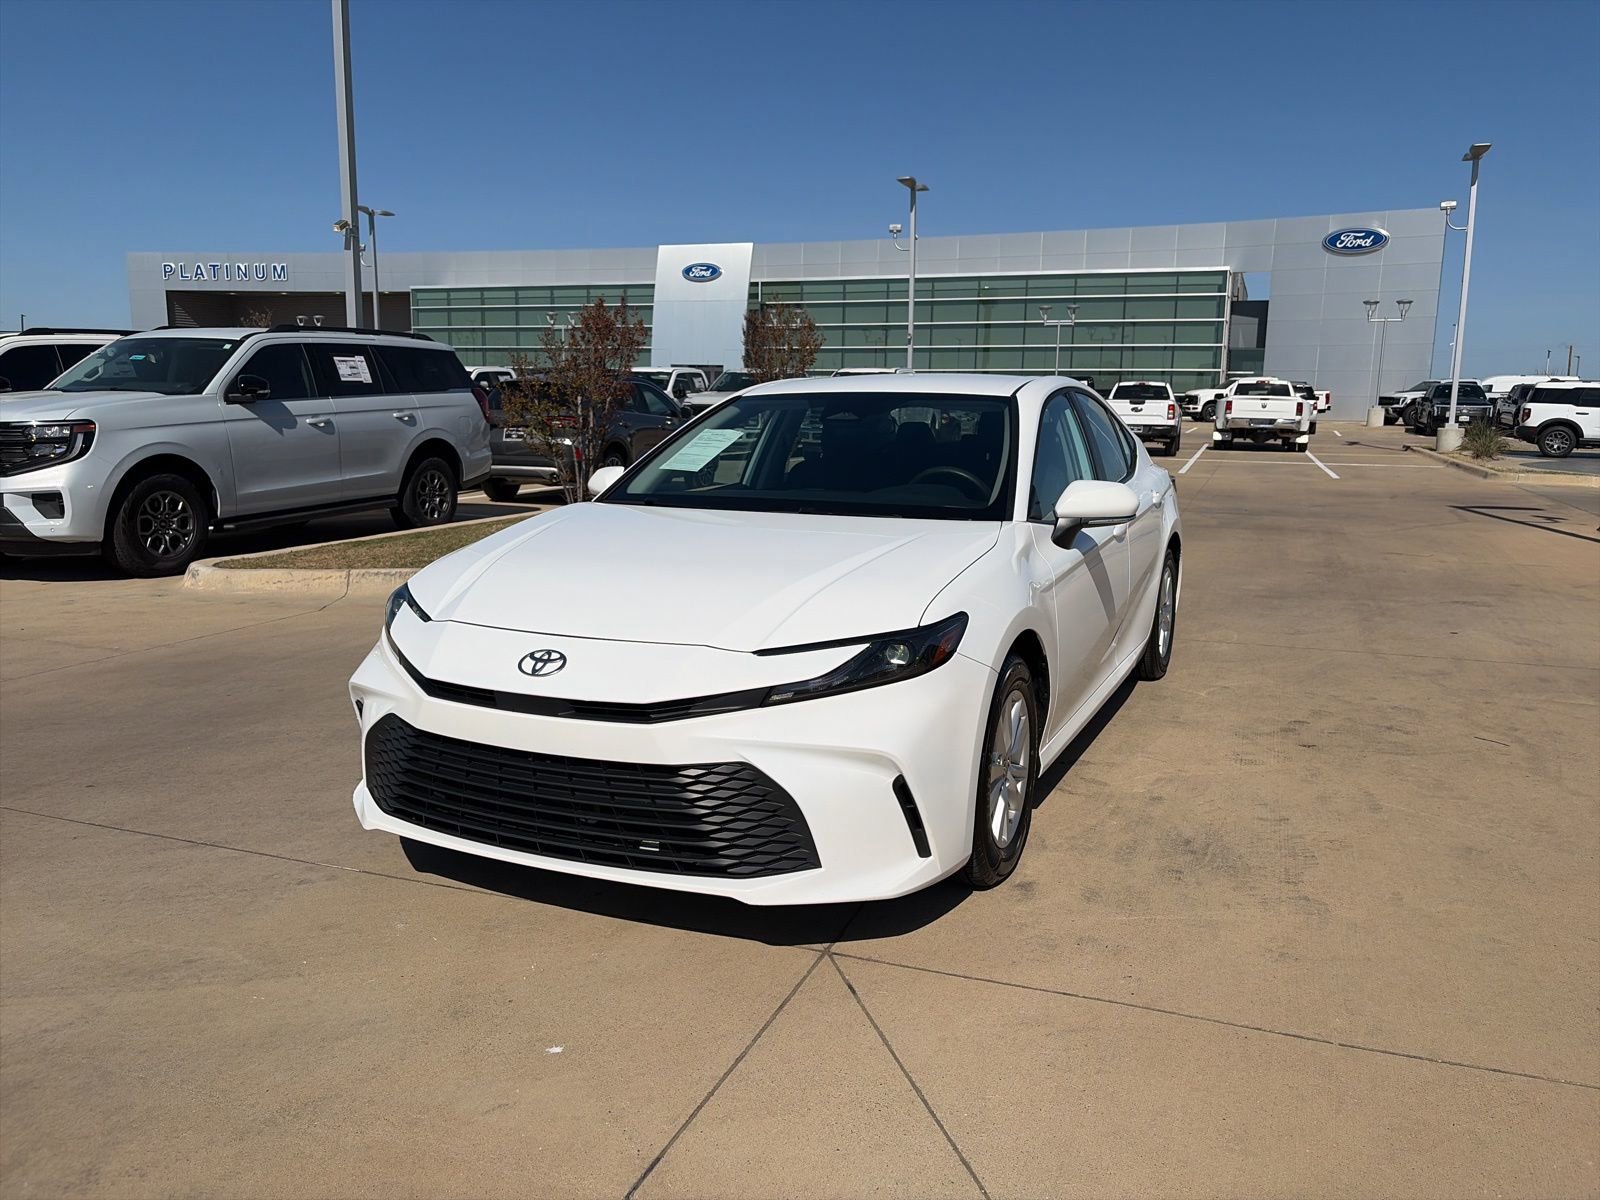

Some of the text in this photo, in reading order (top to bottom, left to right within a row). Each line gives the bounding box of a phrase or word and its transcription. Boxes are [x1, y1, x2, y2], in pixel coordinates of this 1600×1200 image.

[1336, 232, 1374, 248] Ford
[162, 262, 288, 281] PLATINUM
[689, 266, 713, 277] Ford
